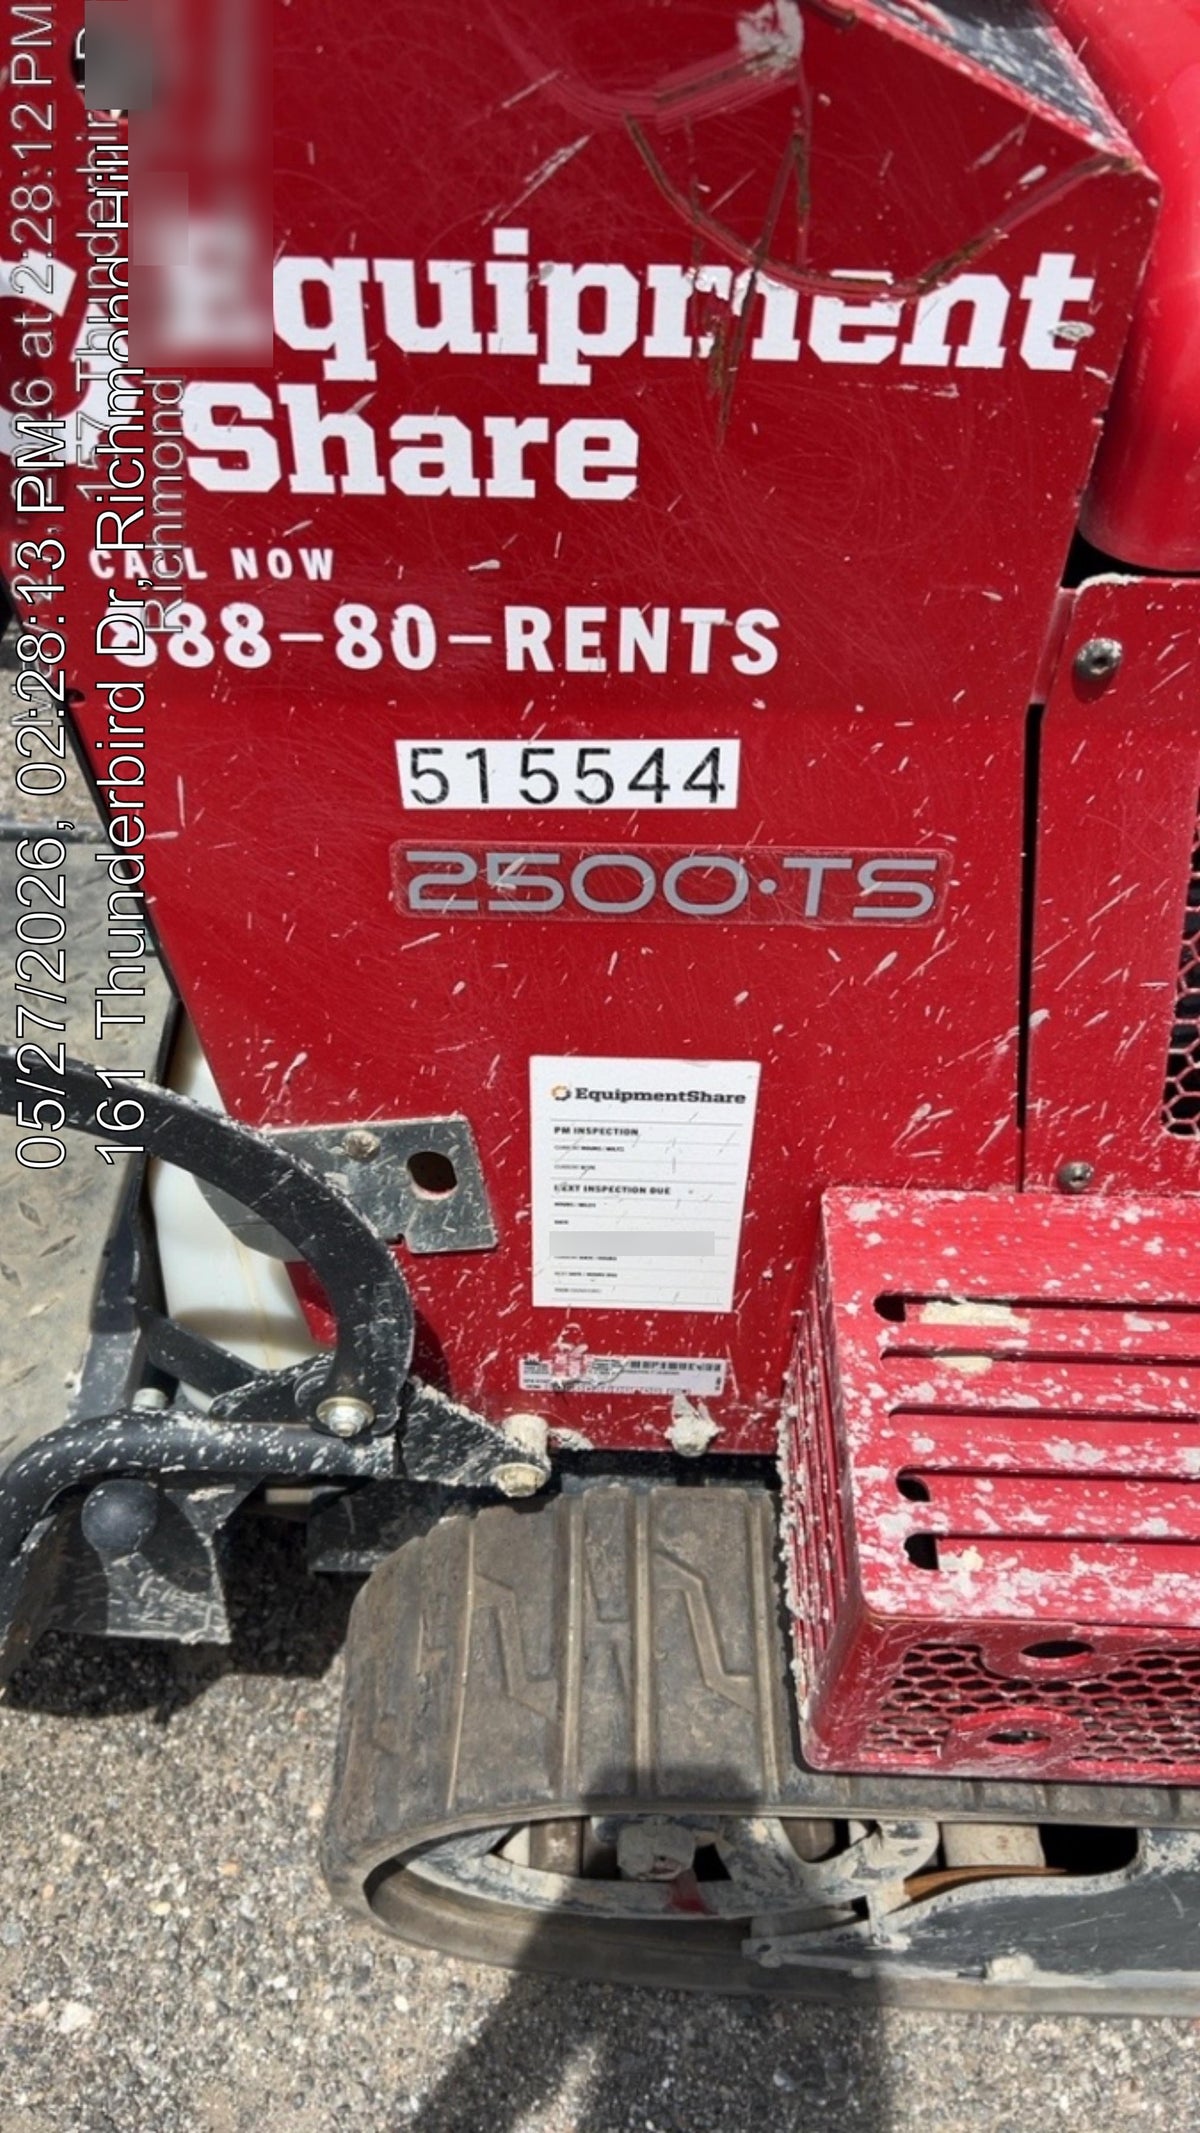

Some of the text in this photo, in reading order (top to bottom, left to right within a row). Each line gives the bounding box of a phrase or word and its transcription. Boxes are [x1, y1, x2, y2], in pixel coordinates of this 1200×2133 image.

[180, 381, 639, 501] Share
[89, 547, 333, 581] CALL NOW
[409, 747, 726, 805] 515544
[575, 1087, 747, 1104] EquipmentShare
[554, 1126, 639, 1136] PM INSPECTION
[583, 1185, 647, 1195] INSPECTION
[649, 1186, 671, 1195] DUE
